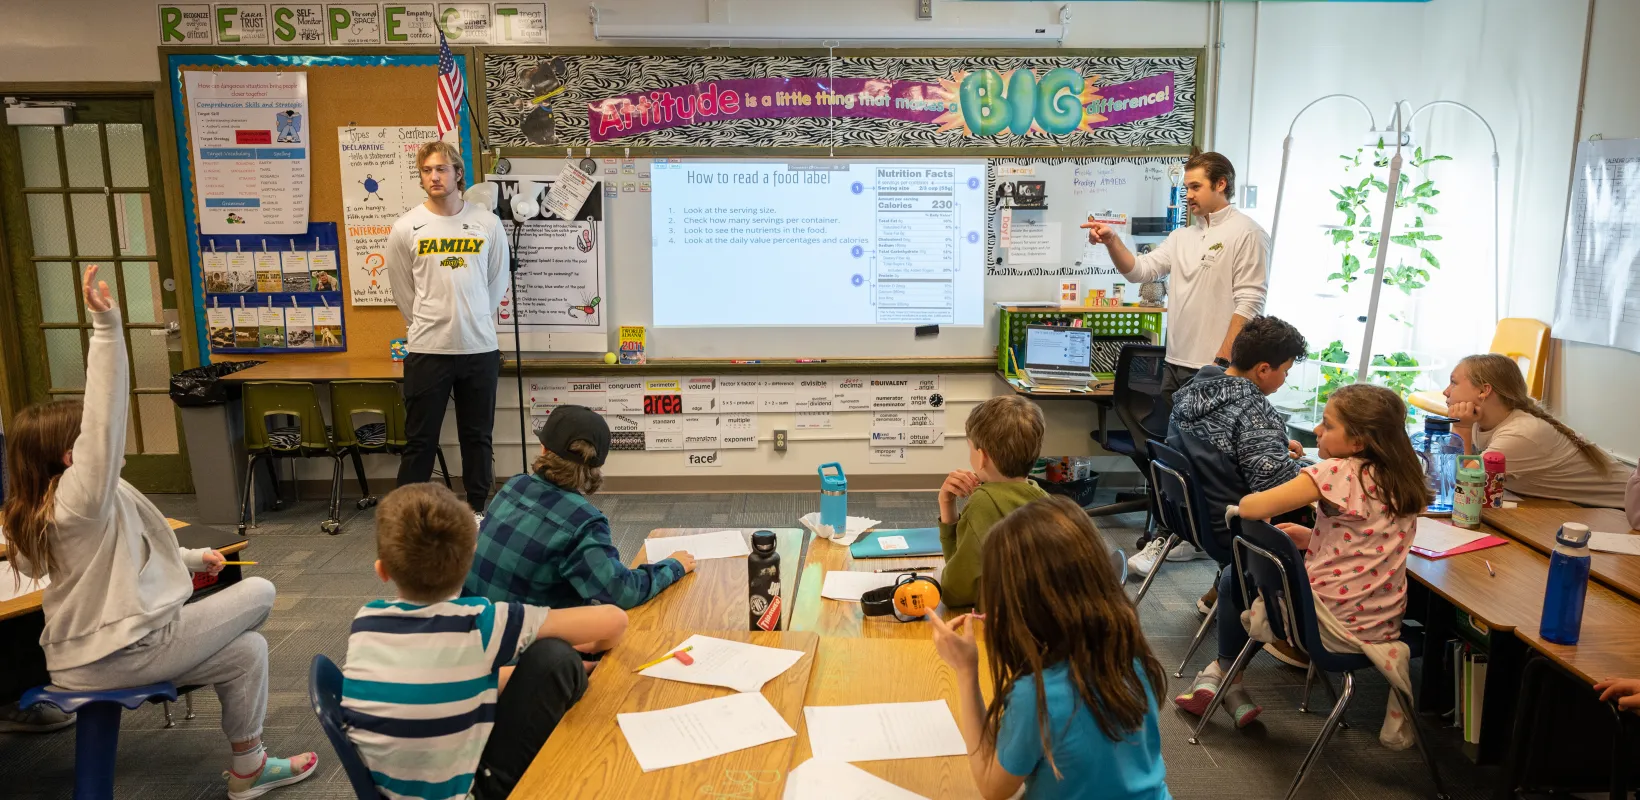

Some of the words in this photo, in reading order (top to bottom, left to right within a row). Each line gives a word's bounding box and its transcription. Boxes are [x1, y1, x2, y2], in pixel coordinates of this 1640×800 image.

[240, 18, 264, 28] TRUST
[297, 17, 322, 25] Monitor
[521, 30, 542, 38] Equal
[598, 83, 740, 136] Attitude
[745, 93, 757, 108] is
[761, 96, 772, 107] a
[776, 92, 811, 106] little
[815, 91, 855, 109] thing
[858, 92, 892, 107] that
[895, 96, 945, 112] makes
[949, 101, 959, 113] a
[960, 67, 1085, 137] BIG
[1086, 85, 1170, 115] difference!
[345, 128, 369, 143] Types
[378, 128, 387, 138] of
[369, 152, 395, 160] statement
[878, 169, 922, 178] Nutrition
[926, 170, 953, 178] Facts
[687, 170, 713, 184] How
[717, 172, 729, 184] to
[733, 170, 759, 184] read
[763, 173, 769, 184] a
[773, 170, 799, 187] food
[804, 170, 830, 184] label
[1073, 178, 1096, 187] Prodigy
[932, 200, 952, 209] 230
[729, 207, 758, 216] serving
[729, 218, 750, 226] many
[752, 217, 784, 226] servings
[786, 218, 799, 226] per
[1000, 216, 1010, 234] Day
[348, 226, 392, 236] INTERROGAT
[730, 237, 748, 245] daily
[773, 237, 820, 246] percentages
[418, 239, 484, 254] FAMILY
[622, 341, 642, 350] 2011
[644, 395, 682, 414] area
[616, 414, 638, 425] rotation
[689, 454, 713, 464] face
